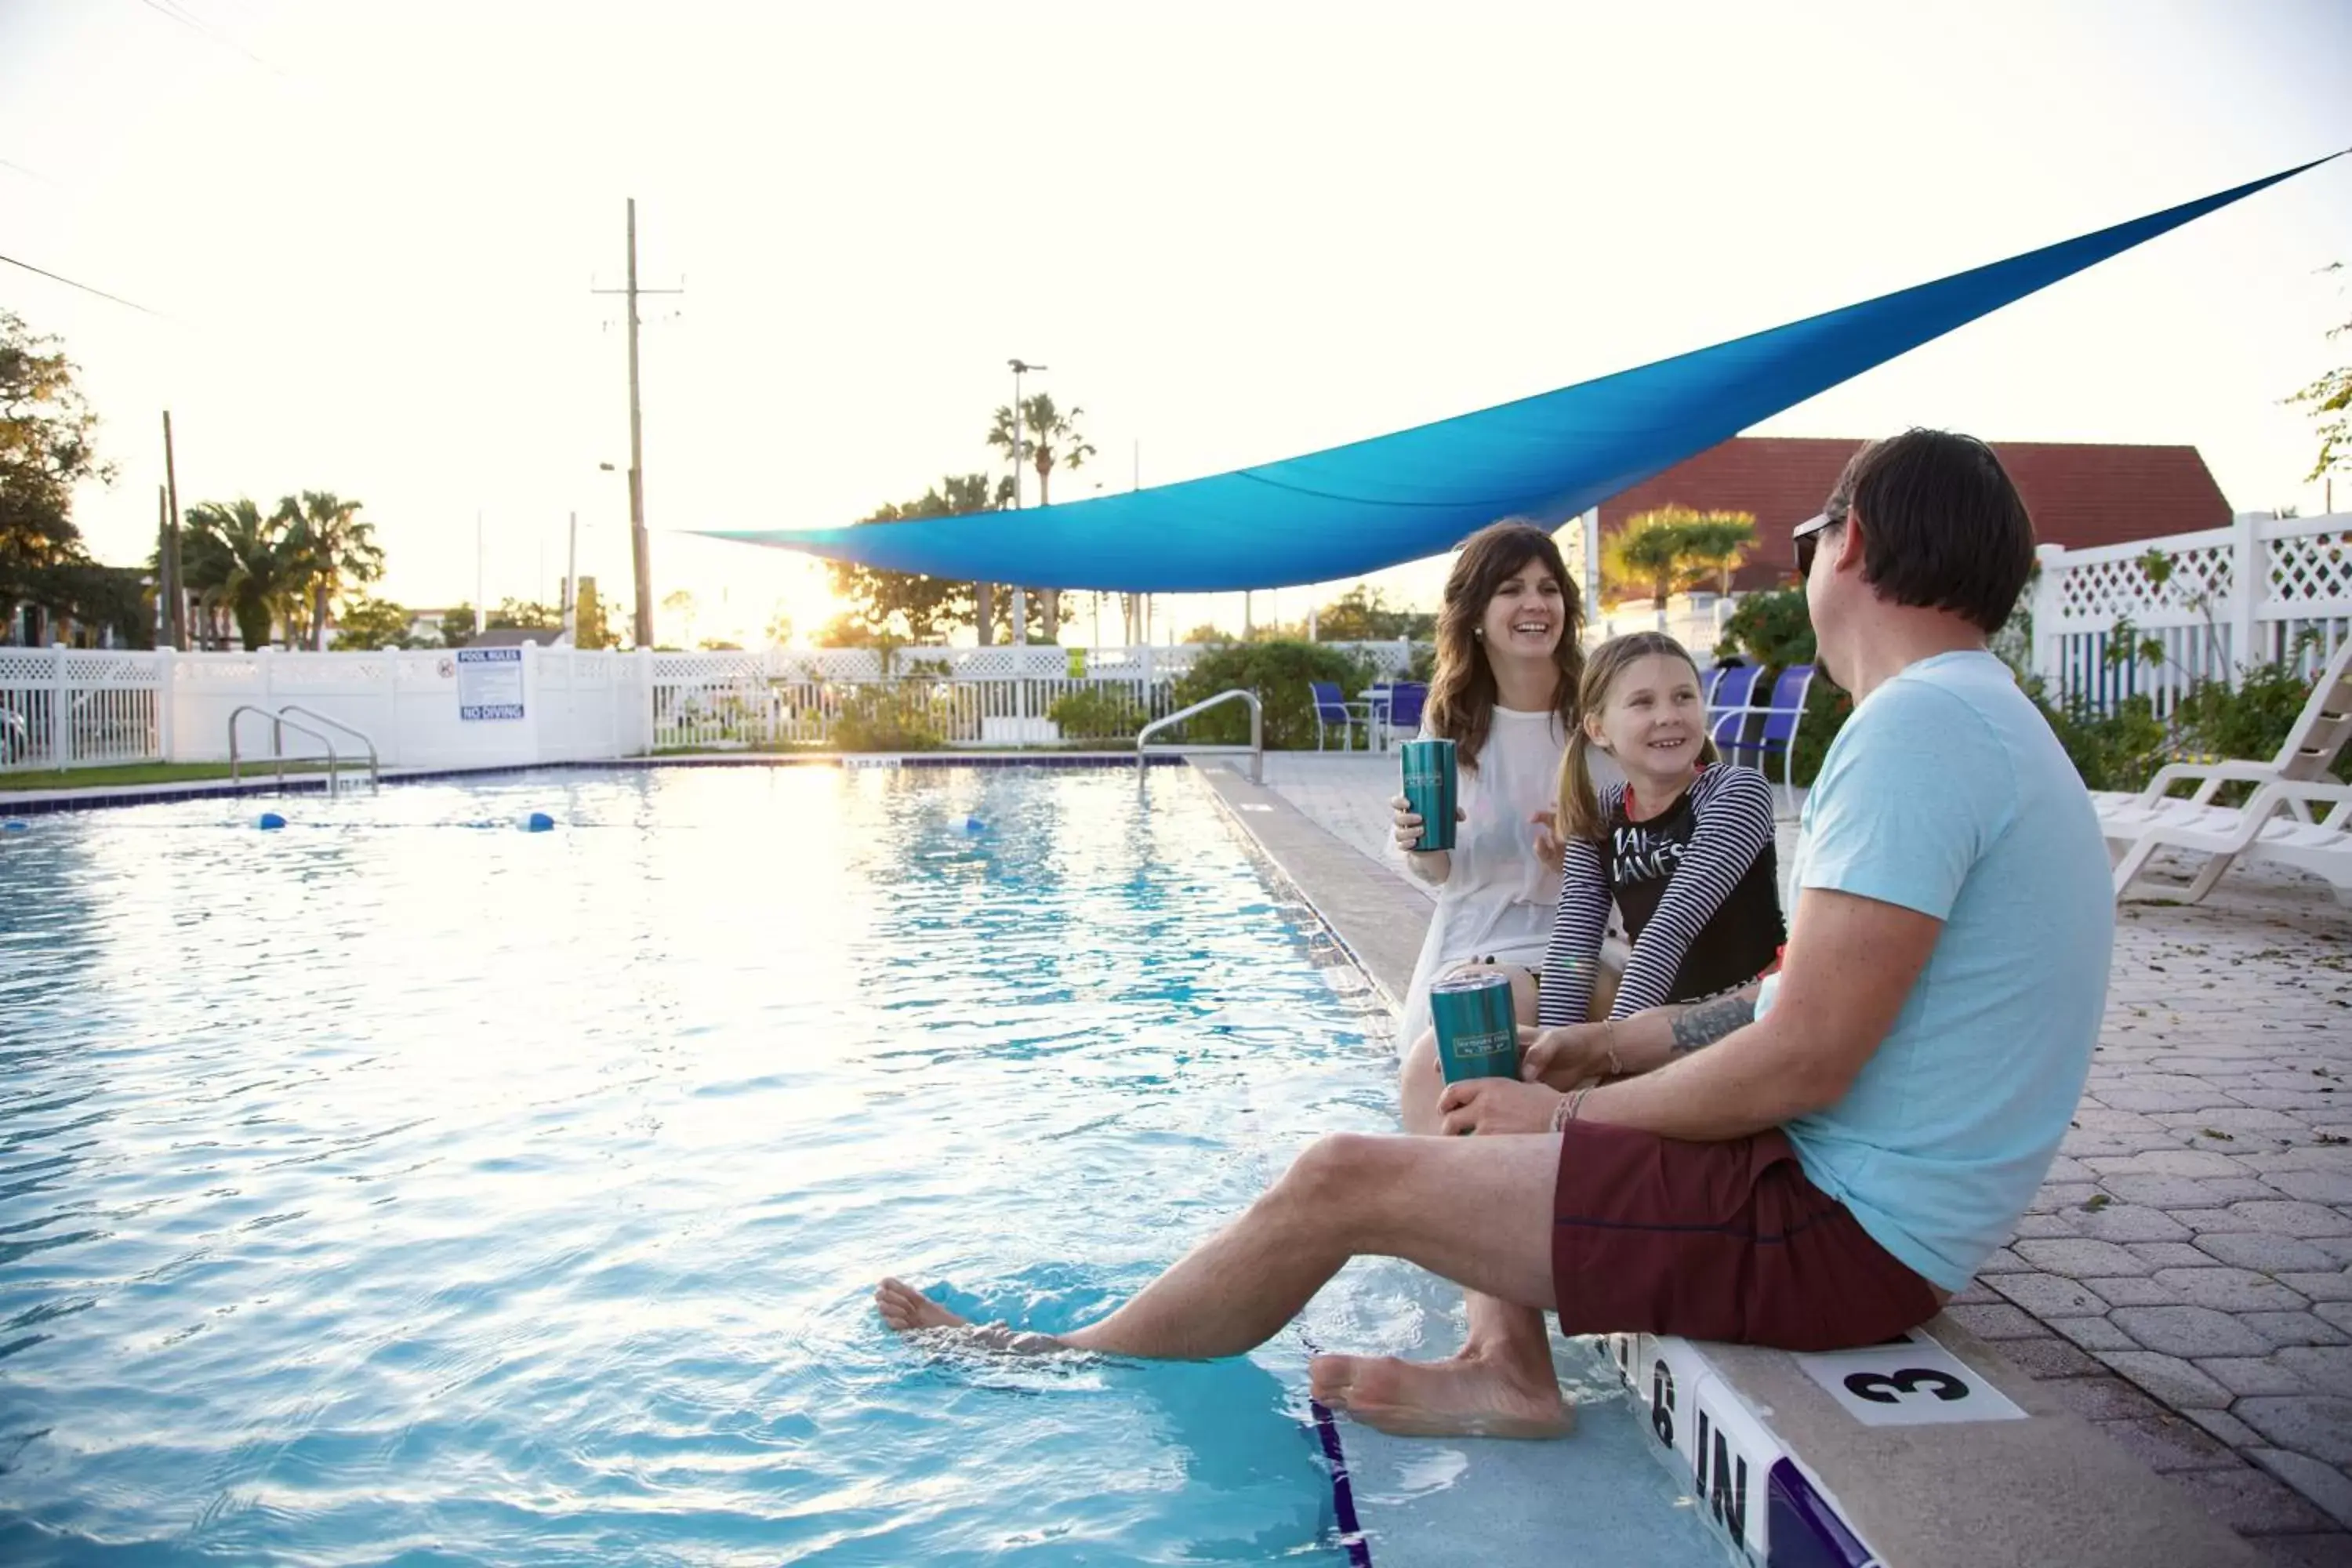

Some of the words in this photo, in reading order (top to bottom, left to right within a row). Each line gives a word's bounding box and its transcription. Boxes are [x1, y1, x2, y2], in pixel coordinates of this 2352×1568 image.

[463, 706, 481, 719] NO
[483, 705, 520, 718] DIVING
[1844, 1368, 1970, 1404] 3
[1697, 1410, 1748, 1554] IN
